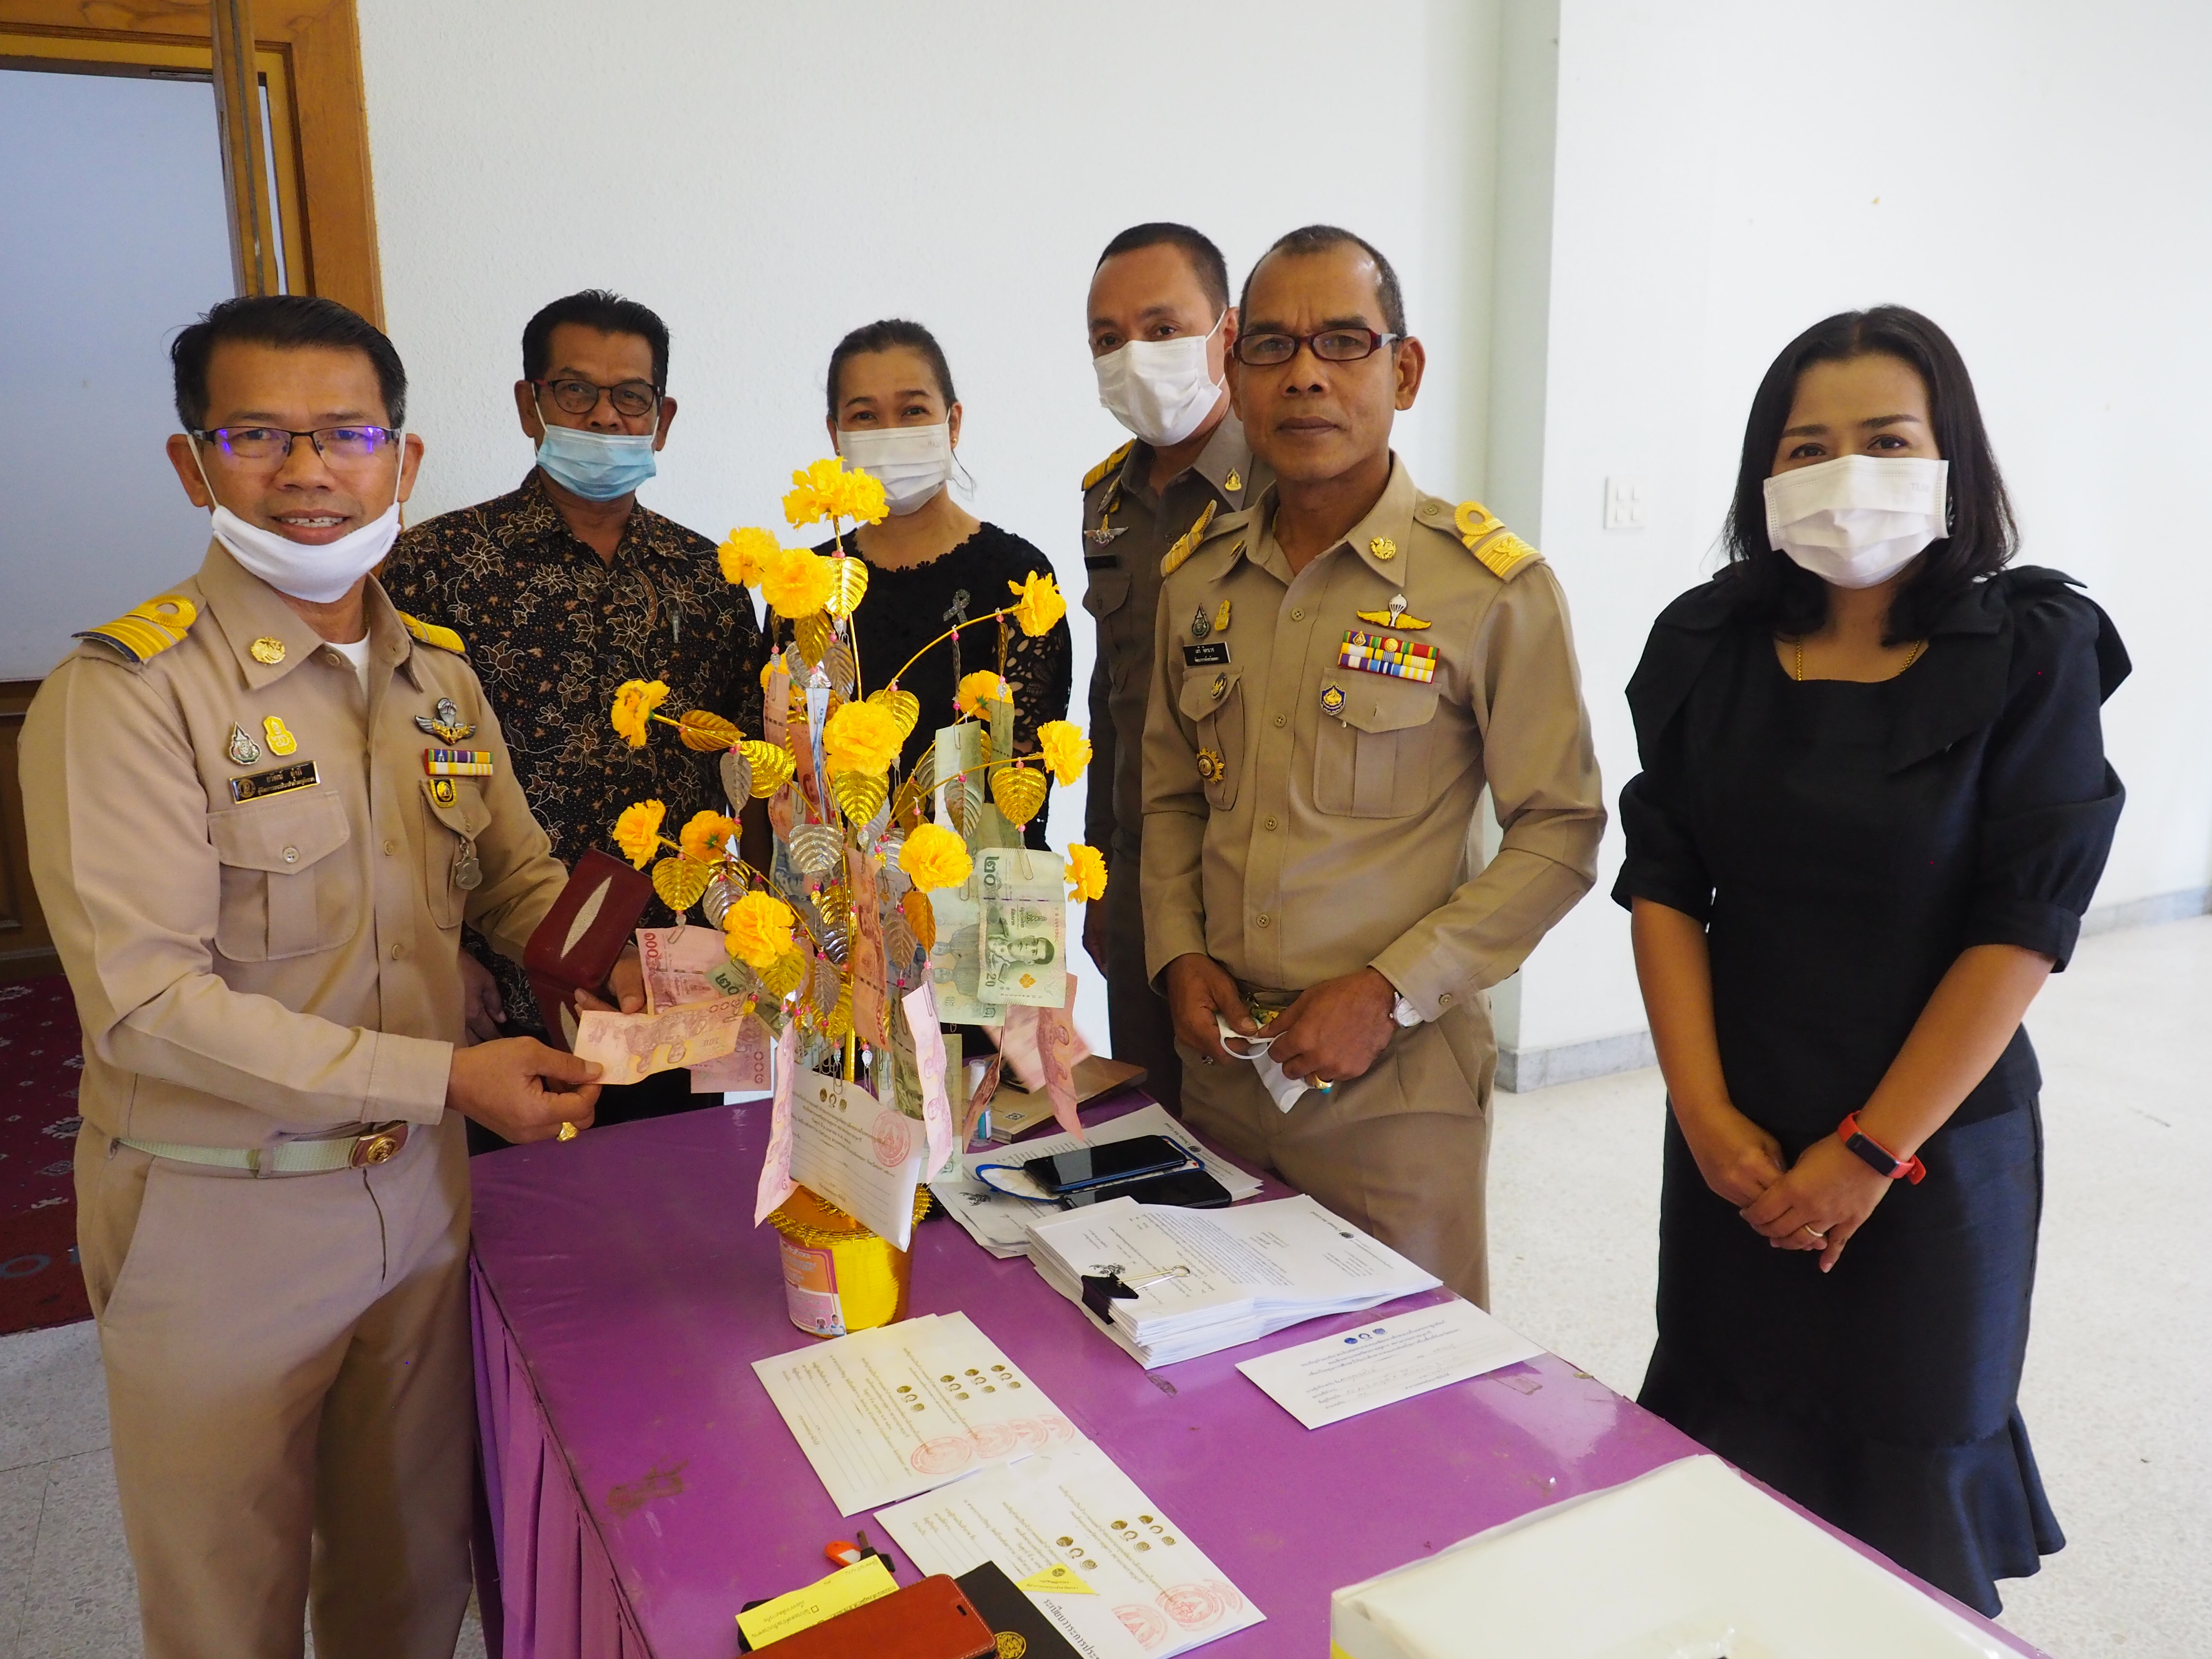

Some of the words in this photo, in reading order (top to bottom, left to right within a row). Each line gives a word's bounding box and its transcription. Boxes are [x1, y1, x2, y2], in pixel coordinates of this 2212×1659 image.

[984, 856, 999, 886] ๒๐
[644, 932, 659, 958] ๑๐๐
[715, 973, 740, 995] ๒๐
[985, 973, 997, 987] 20
[945, 997, 955, 1006] 20
[754, 1051, 764, 1084] ๑๐๐
[1044, 1599, 1099, 1659] ระเบียบวาระการประ
